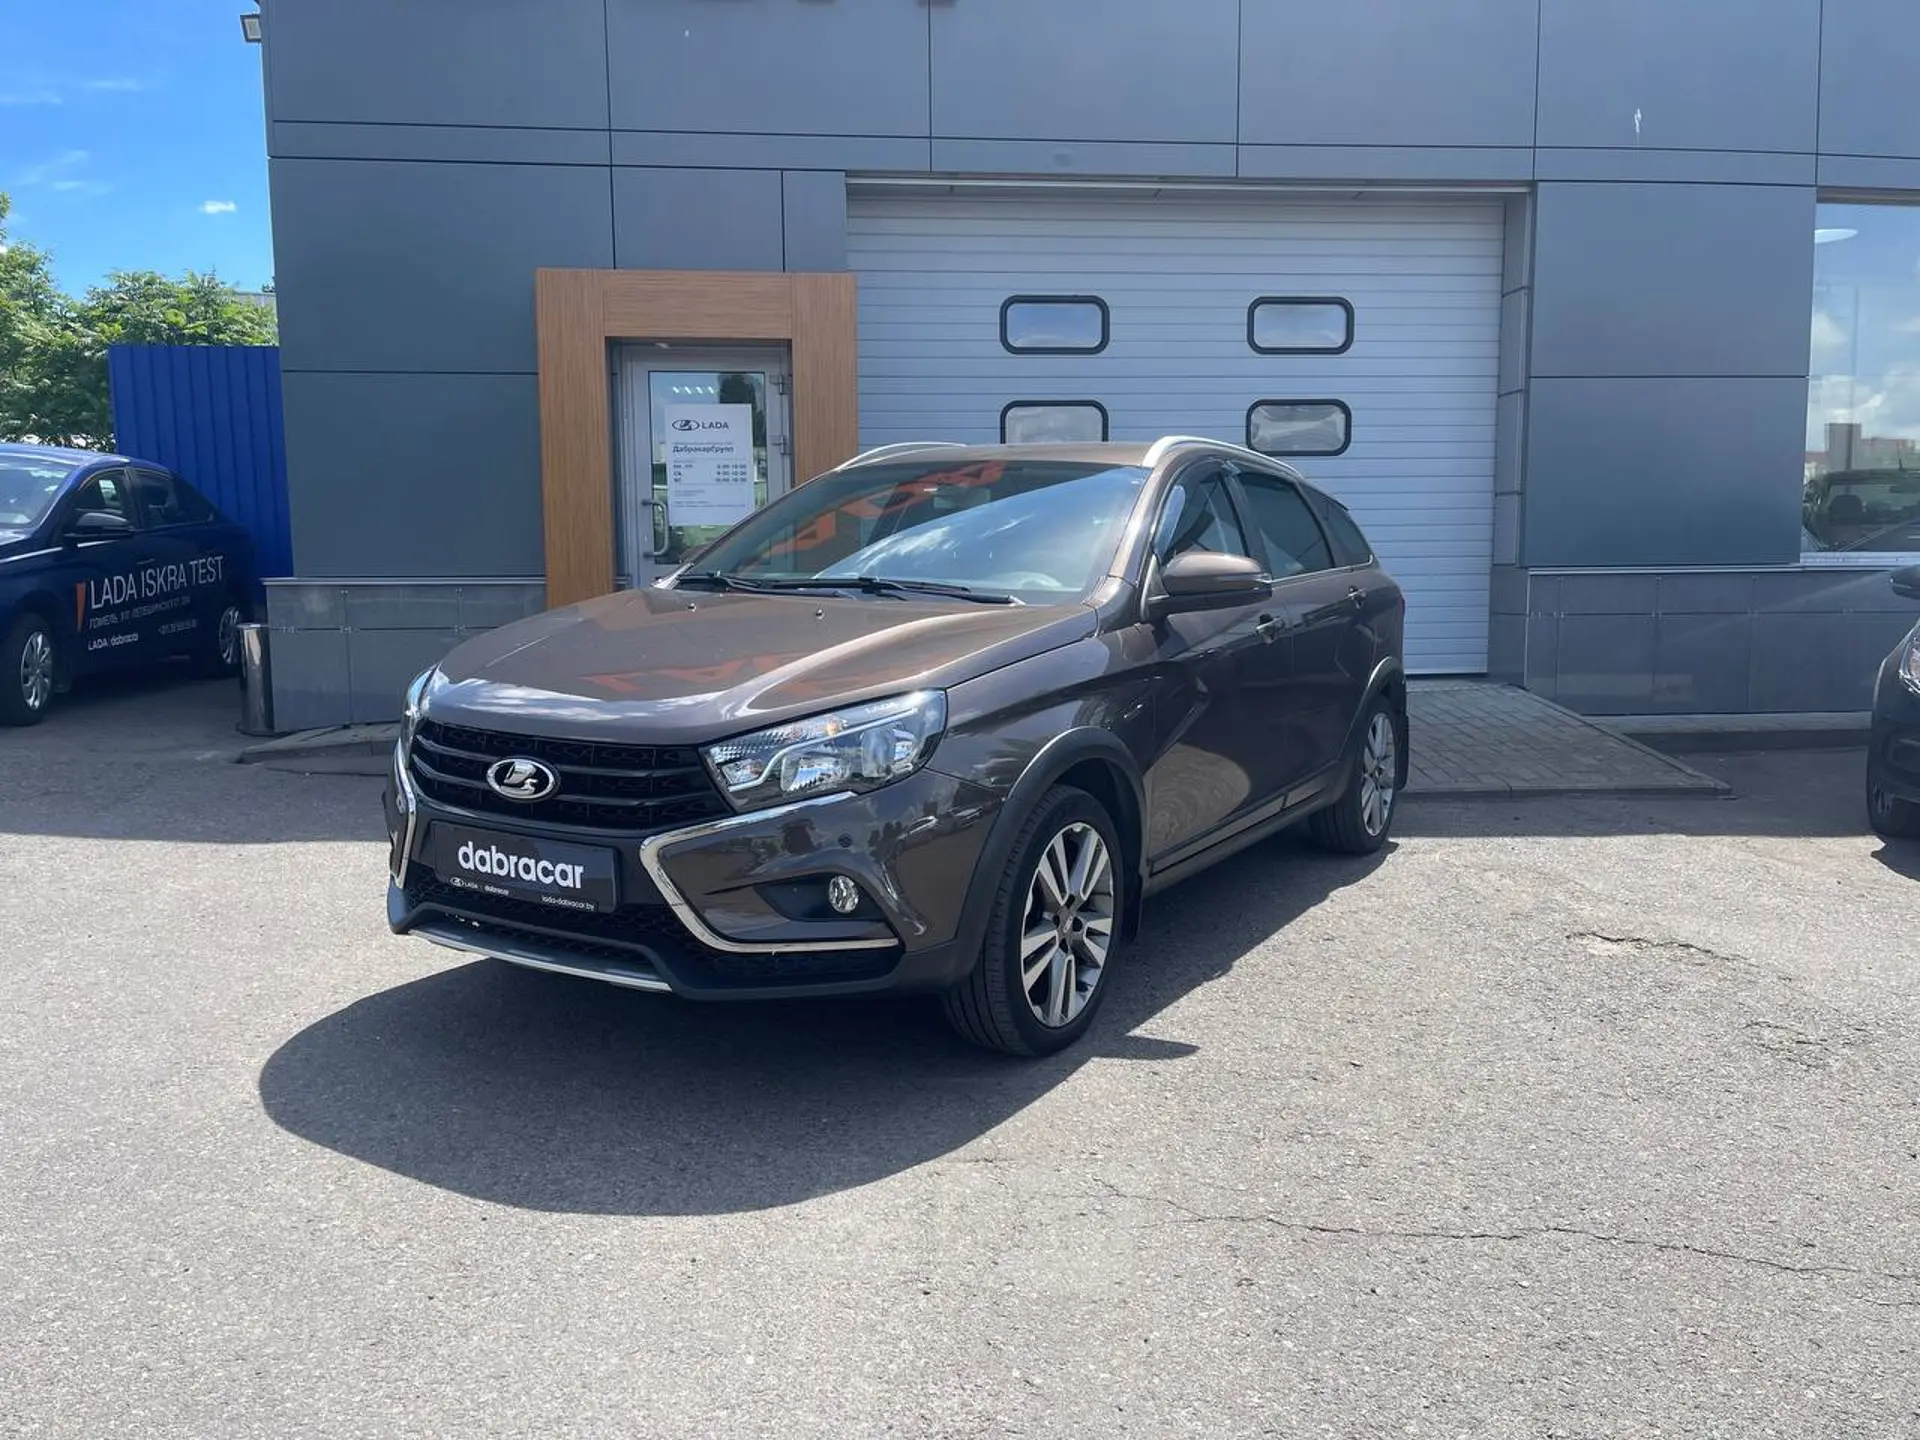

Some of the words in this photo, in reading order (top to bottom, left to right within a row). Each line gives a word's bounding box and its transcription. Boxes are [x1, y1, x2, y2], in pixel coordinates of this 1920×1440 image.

[702, 421, 729, 430] LADA
[90, 572, 138, 609] LADA
[140, 563, 188, 598] ISKRA
[189, 555, 224, 586] TEST
[88, 638, 109, 650] LADA
[458, 841, 584, 889] dabracar
